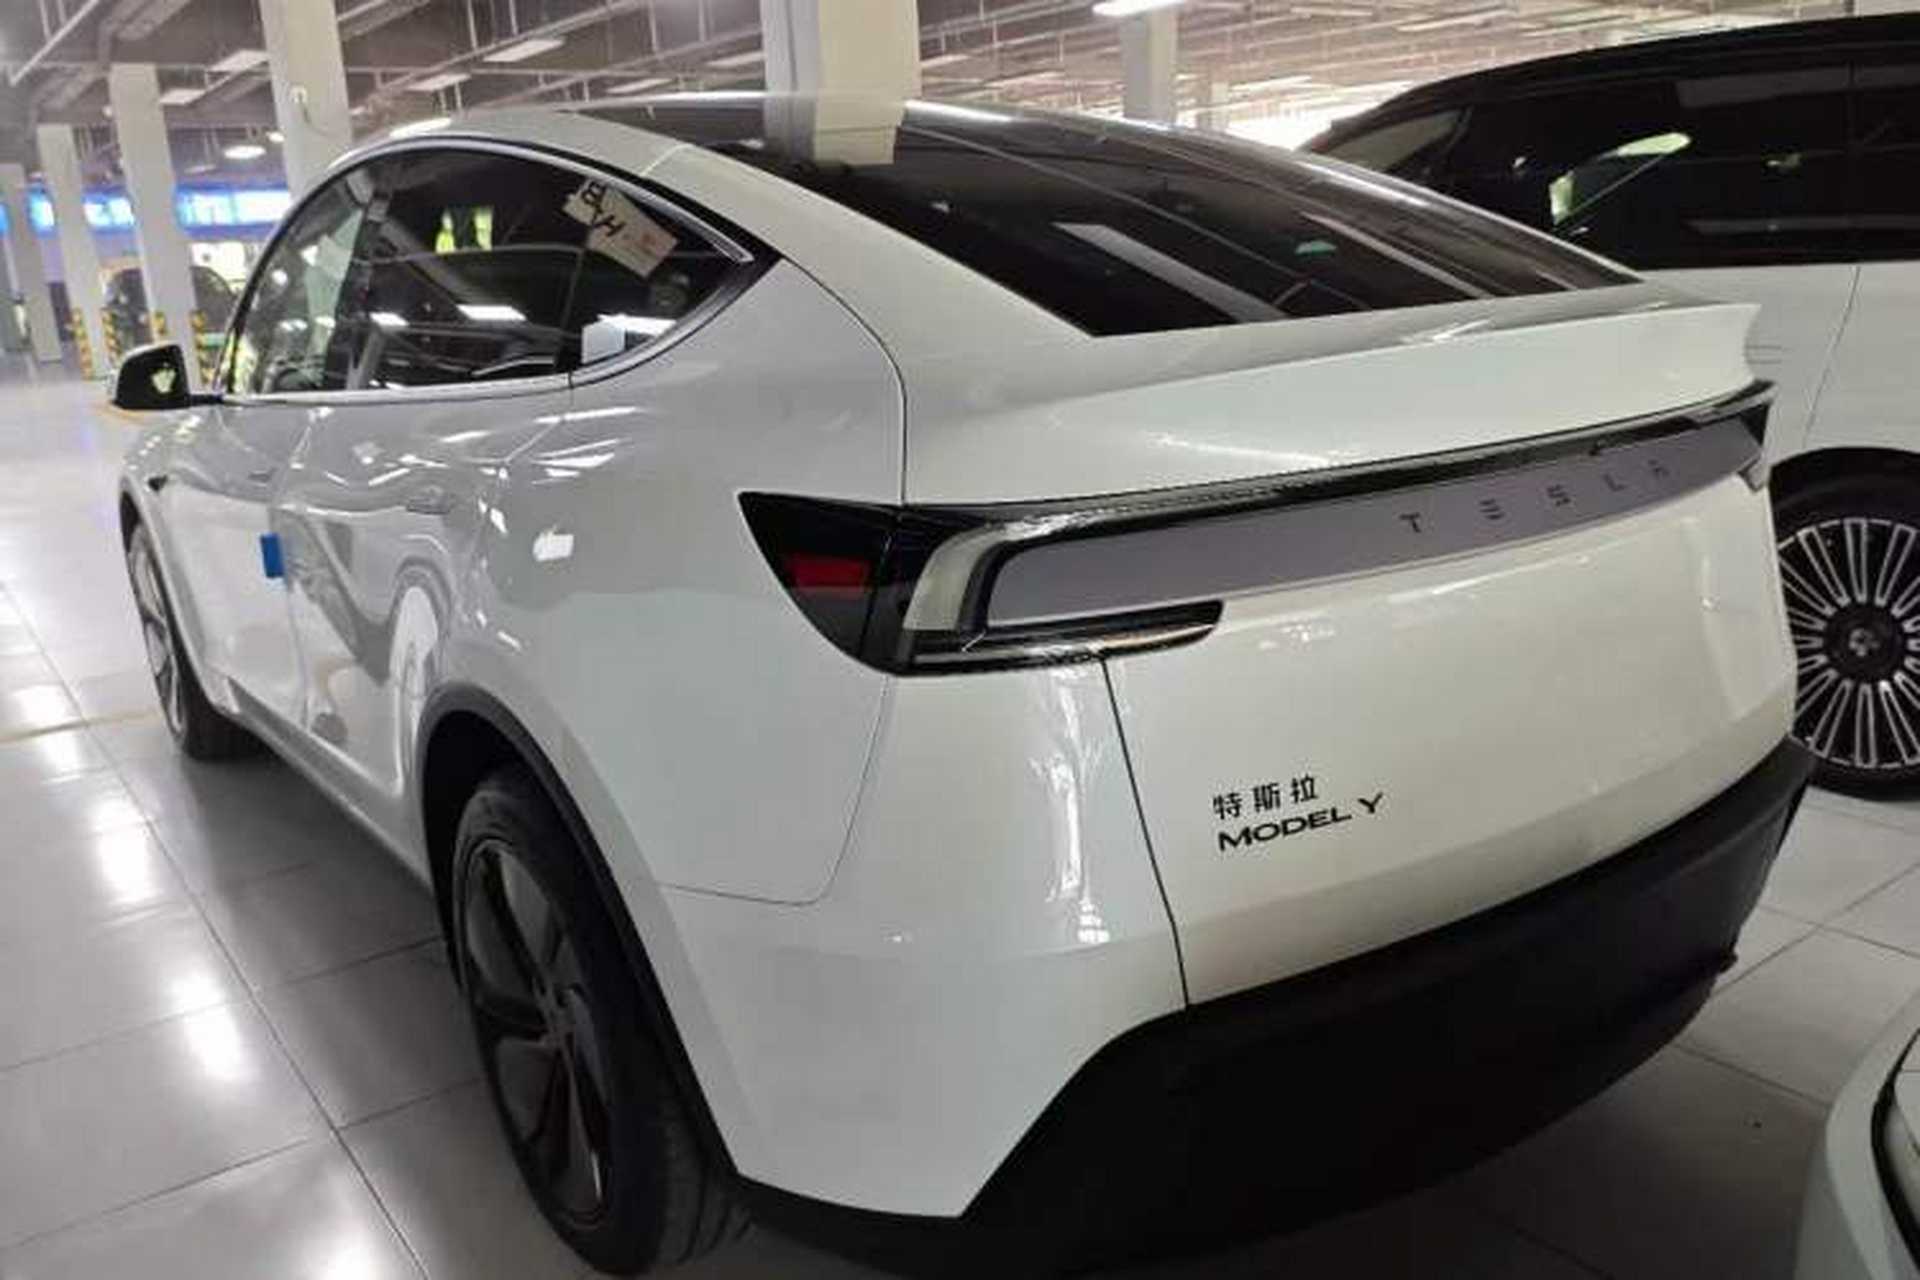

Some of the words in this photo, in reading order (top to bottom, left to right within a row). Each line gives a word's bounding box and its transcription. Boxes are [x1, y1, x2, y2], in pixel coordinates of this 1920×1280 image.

[1399, 458, 1671, 533] TESLA
[1213, 774, 1319, 820] 特斯拉
[1218, 807, 1353, 851] MODEL
[1357, 791, 1384, 814] Y
